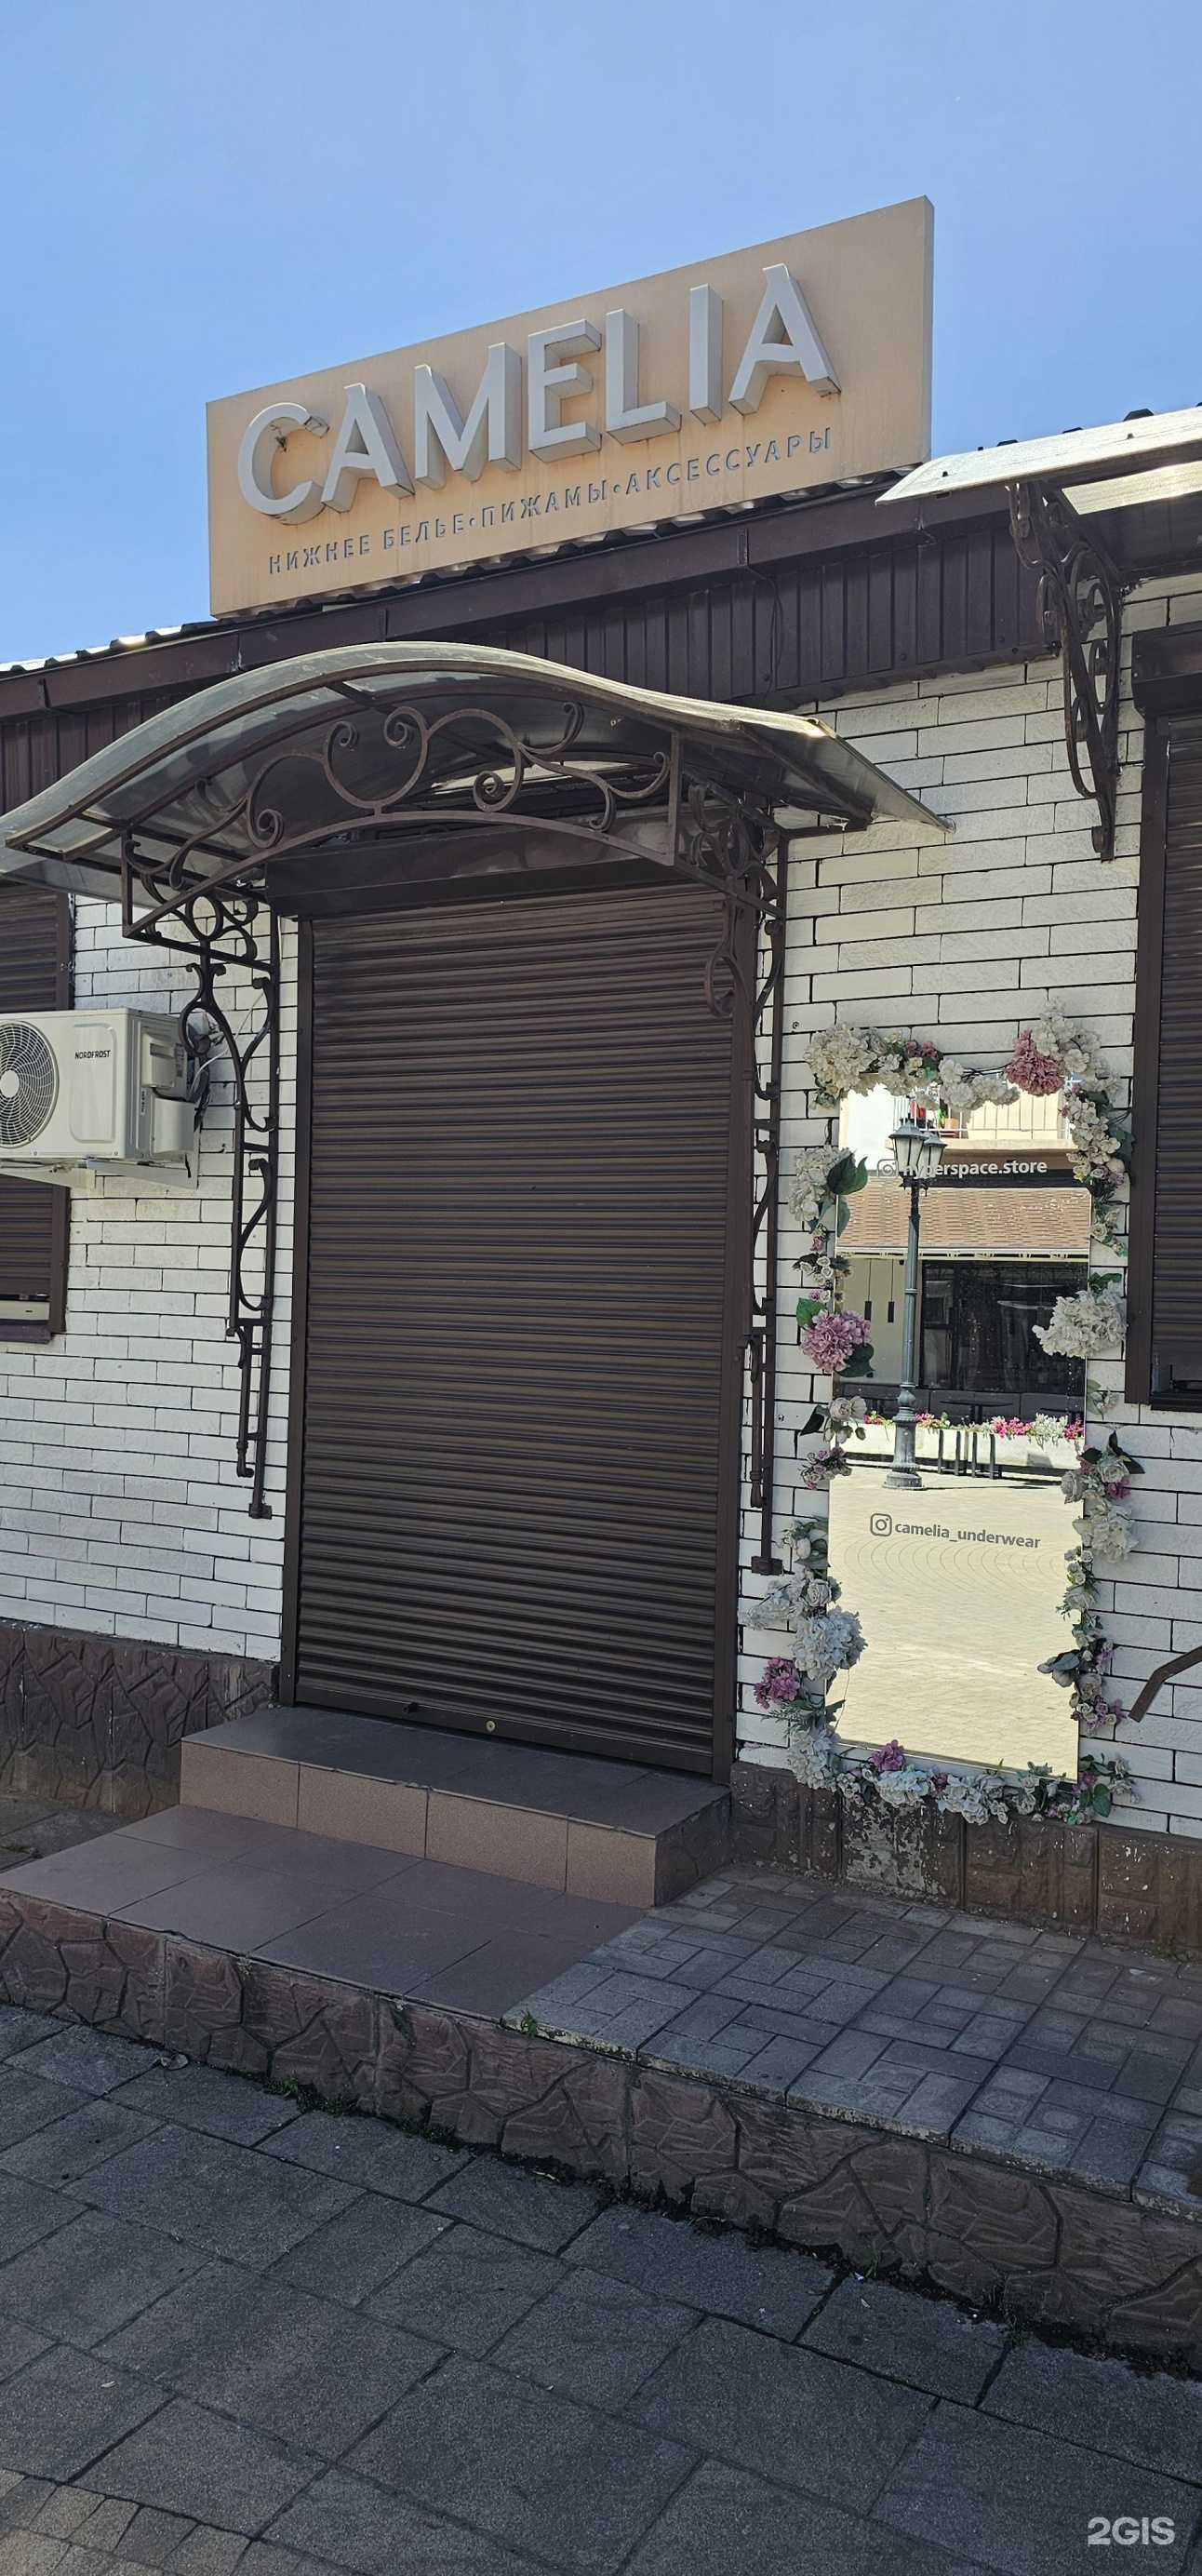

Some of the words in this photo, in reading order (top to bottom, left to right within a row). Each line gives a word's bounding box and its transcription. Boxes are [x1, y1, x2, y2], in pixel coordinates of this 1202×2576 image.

[238, 263, 841, 525] CAMELIA
[269, 534, 370, 575] НИЖНЕЕ
[74, 1050, 111, 1060] NORDFROST
[894, 1523, 1041, 1549] camelia_underwear
